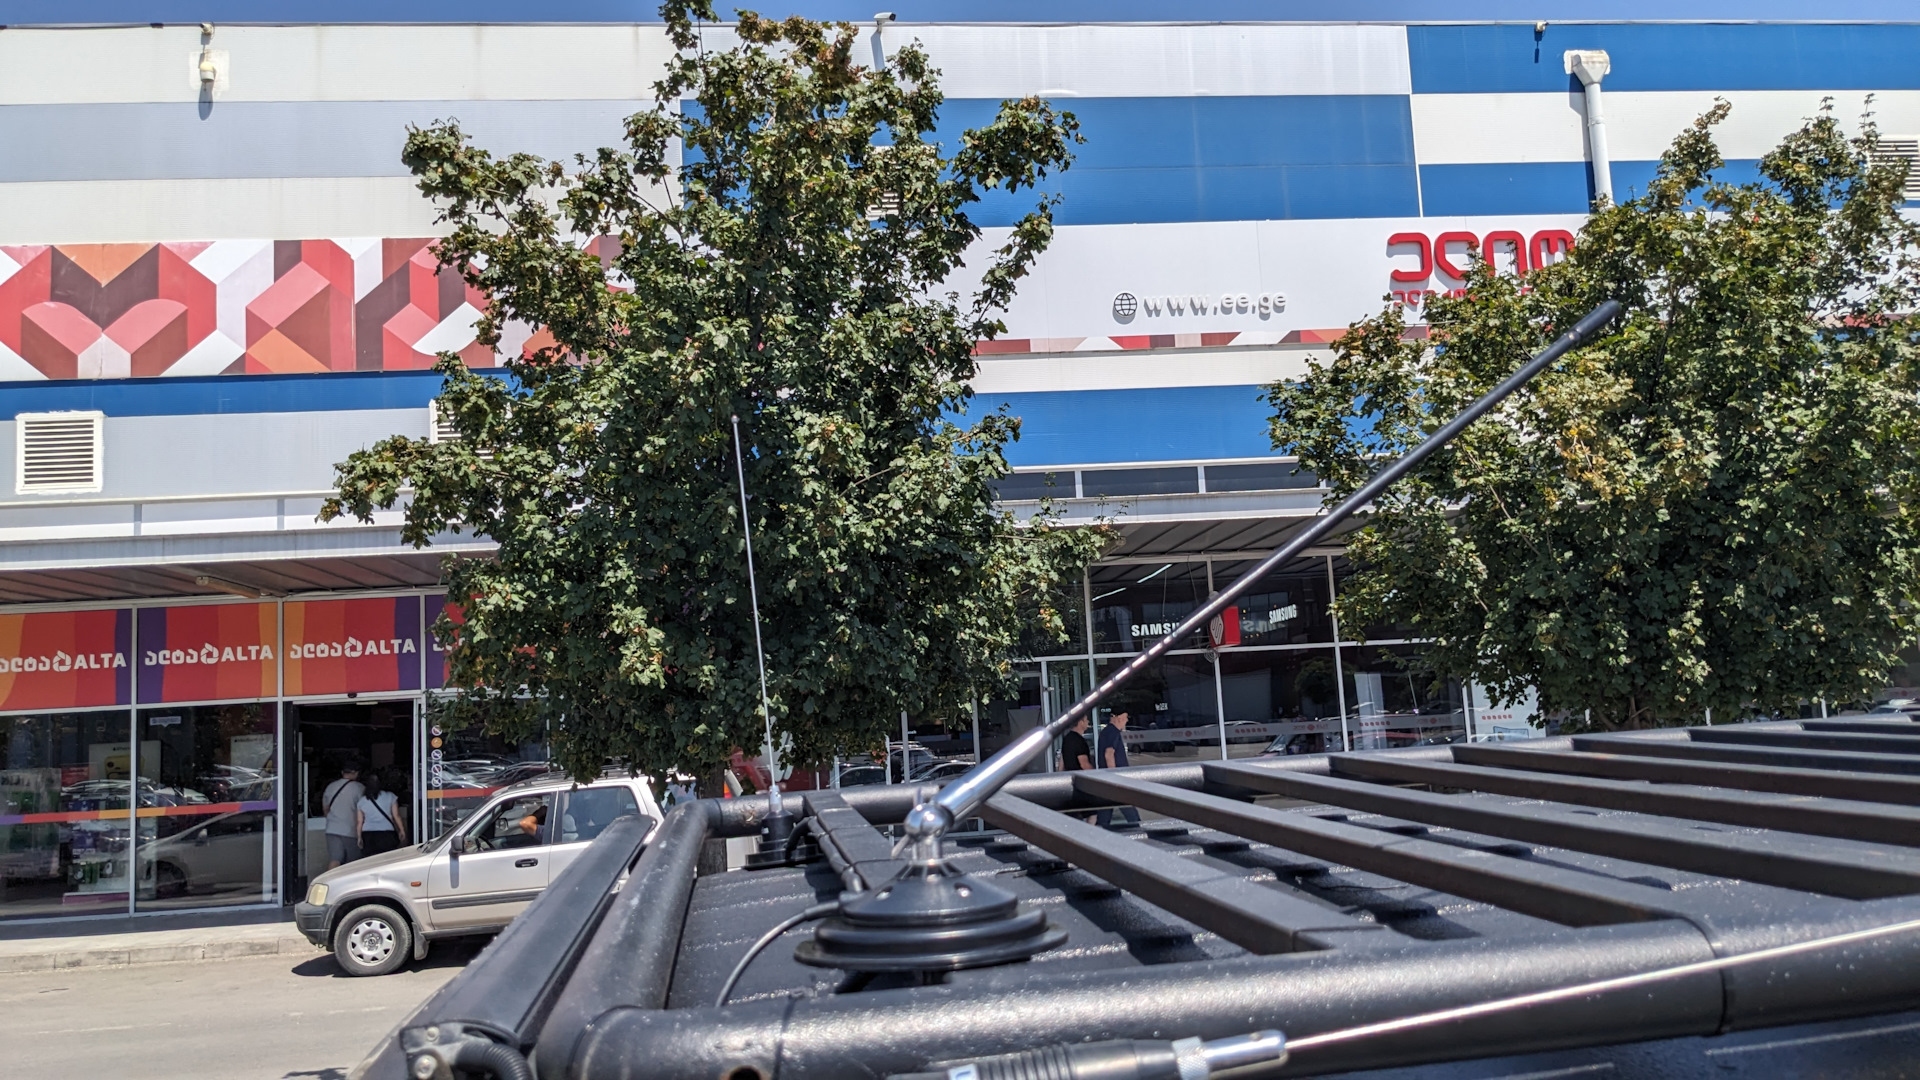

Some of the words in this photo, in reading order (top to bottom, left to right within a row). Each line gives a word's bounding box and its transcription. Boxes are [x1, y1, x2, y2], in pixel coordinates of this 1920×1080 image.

[1144, 292, 1286, 316] www.ee.ge
[1269, 604, 1297, 624] SAMSUNG
[221, 645, 274, 662] ALTA
[365, 638, 416, 655] ALTA
[74, 653, 127, 670] ALTA
